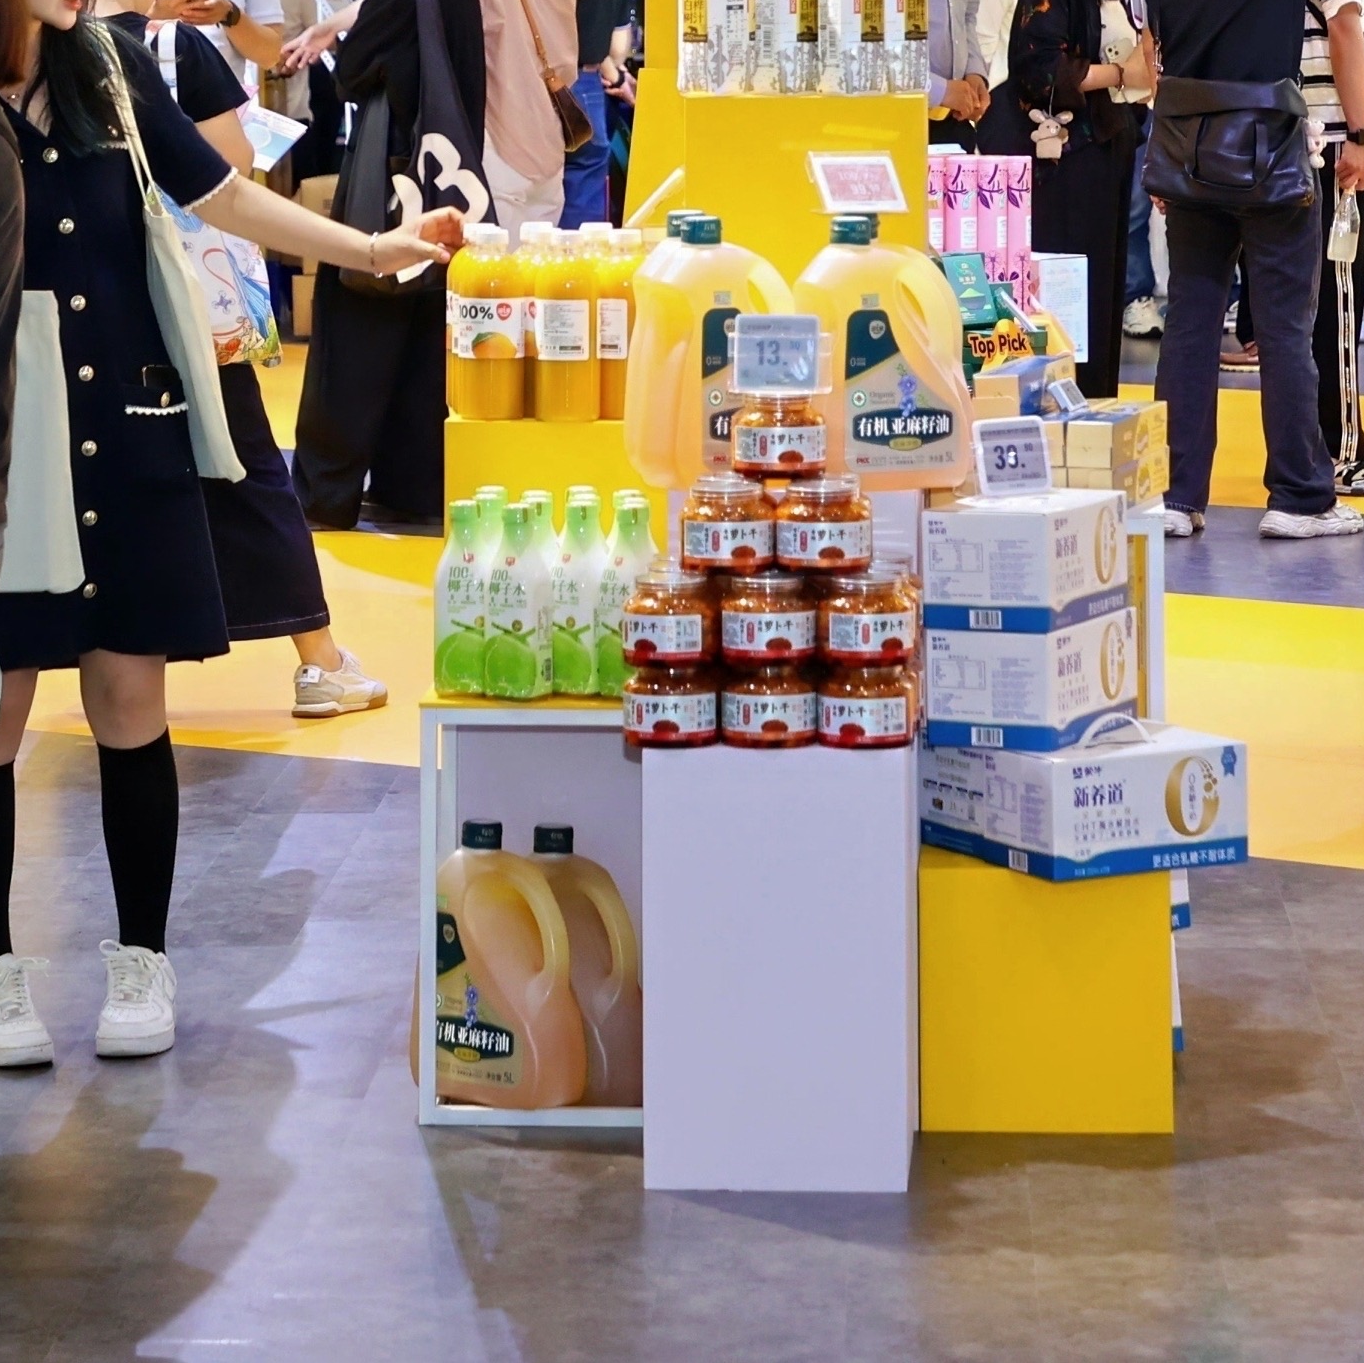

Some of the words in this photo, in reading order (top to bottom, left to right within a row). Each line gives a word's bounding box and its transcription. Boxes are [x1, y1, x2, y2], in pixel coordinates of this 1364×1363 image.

[970, 336, 995, 356] Top
[998, 332, 1027, 352] Pick
[755, 340, 788, 373] 13.
[857, 416, 950, 437] 有机亚麻籽油
[730, 527, 758, 541] 萝卜干
[817, 527, 846, 541] 萝卜干
[489, 581, 526, 596] 椰子水
[600, 582, 630, 596] 椰子水
[765, 619, 793, 633] 萝卜干
[1057, 651, 1083, 678] 新养道
[651, 702, 680, 715] 萝卜干
[760, 701, 790, 715] 萝卜干
[838, 705, 867, 719] 萝卜干
[1073, 782, 1123, 808] 新养道
[1152, 847, 1236, 869] 更适合乳糖不耐体质
